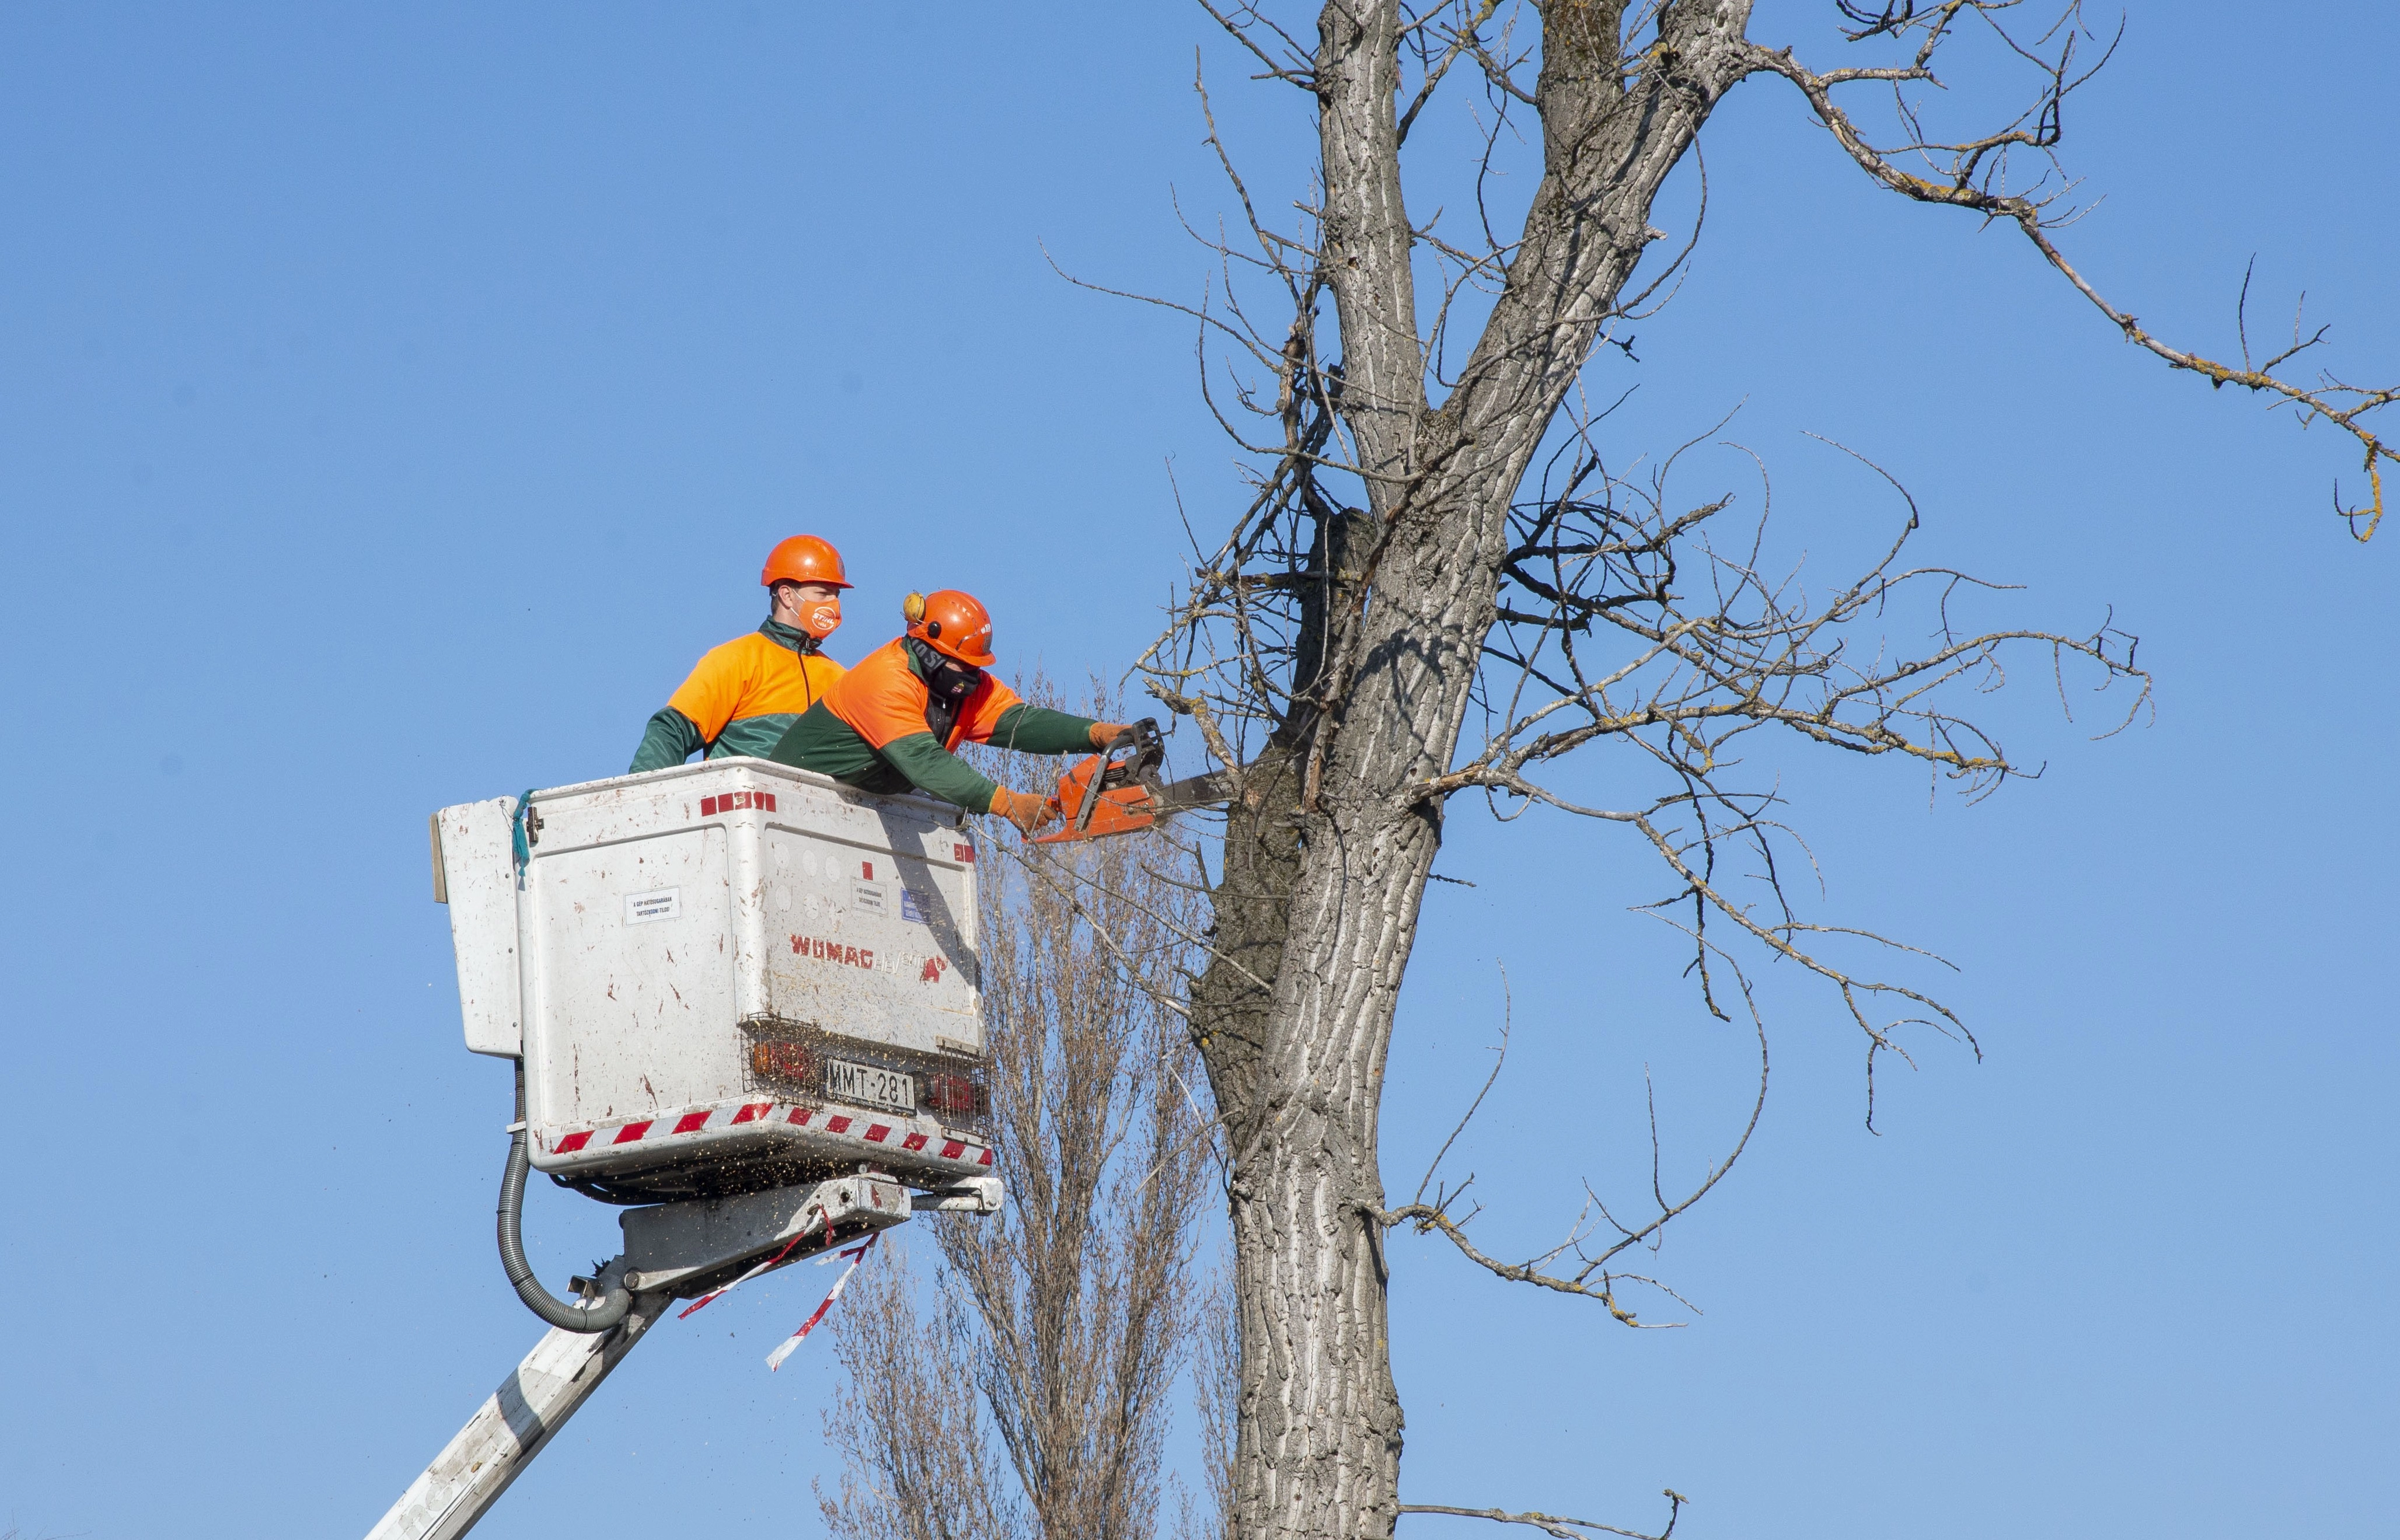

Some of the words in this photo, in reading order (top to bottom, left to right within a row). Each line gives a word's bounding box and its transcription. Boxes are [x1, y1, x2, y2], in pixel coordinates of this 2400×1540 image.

[812, 613, 835, 624] STIHL
[790, 934, 874, 970] WUMAG
[829, 1059, 908, 1105] MMT-281
